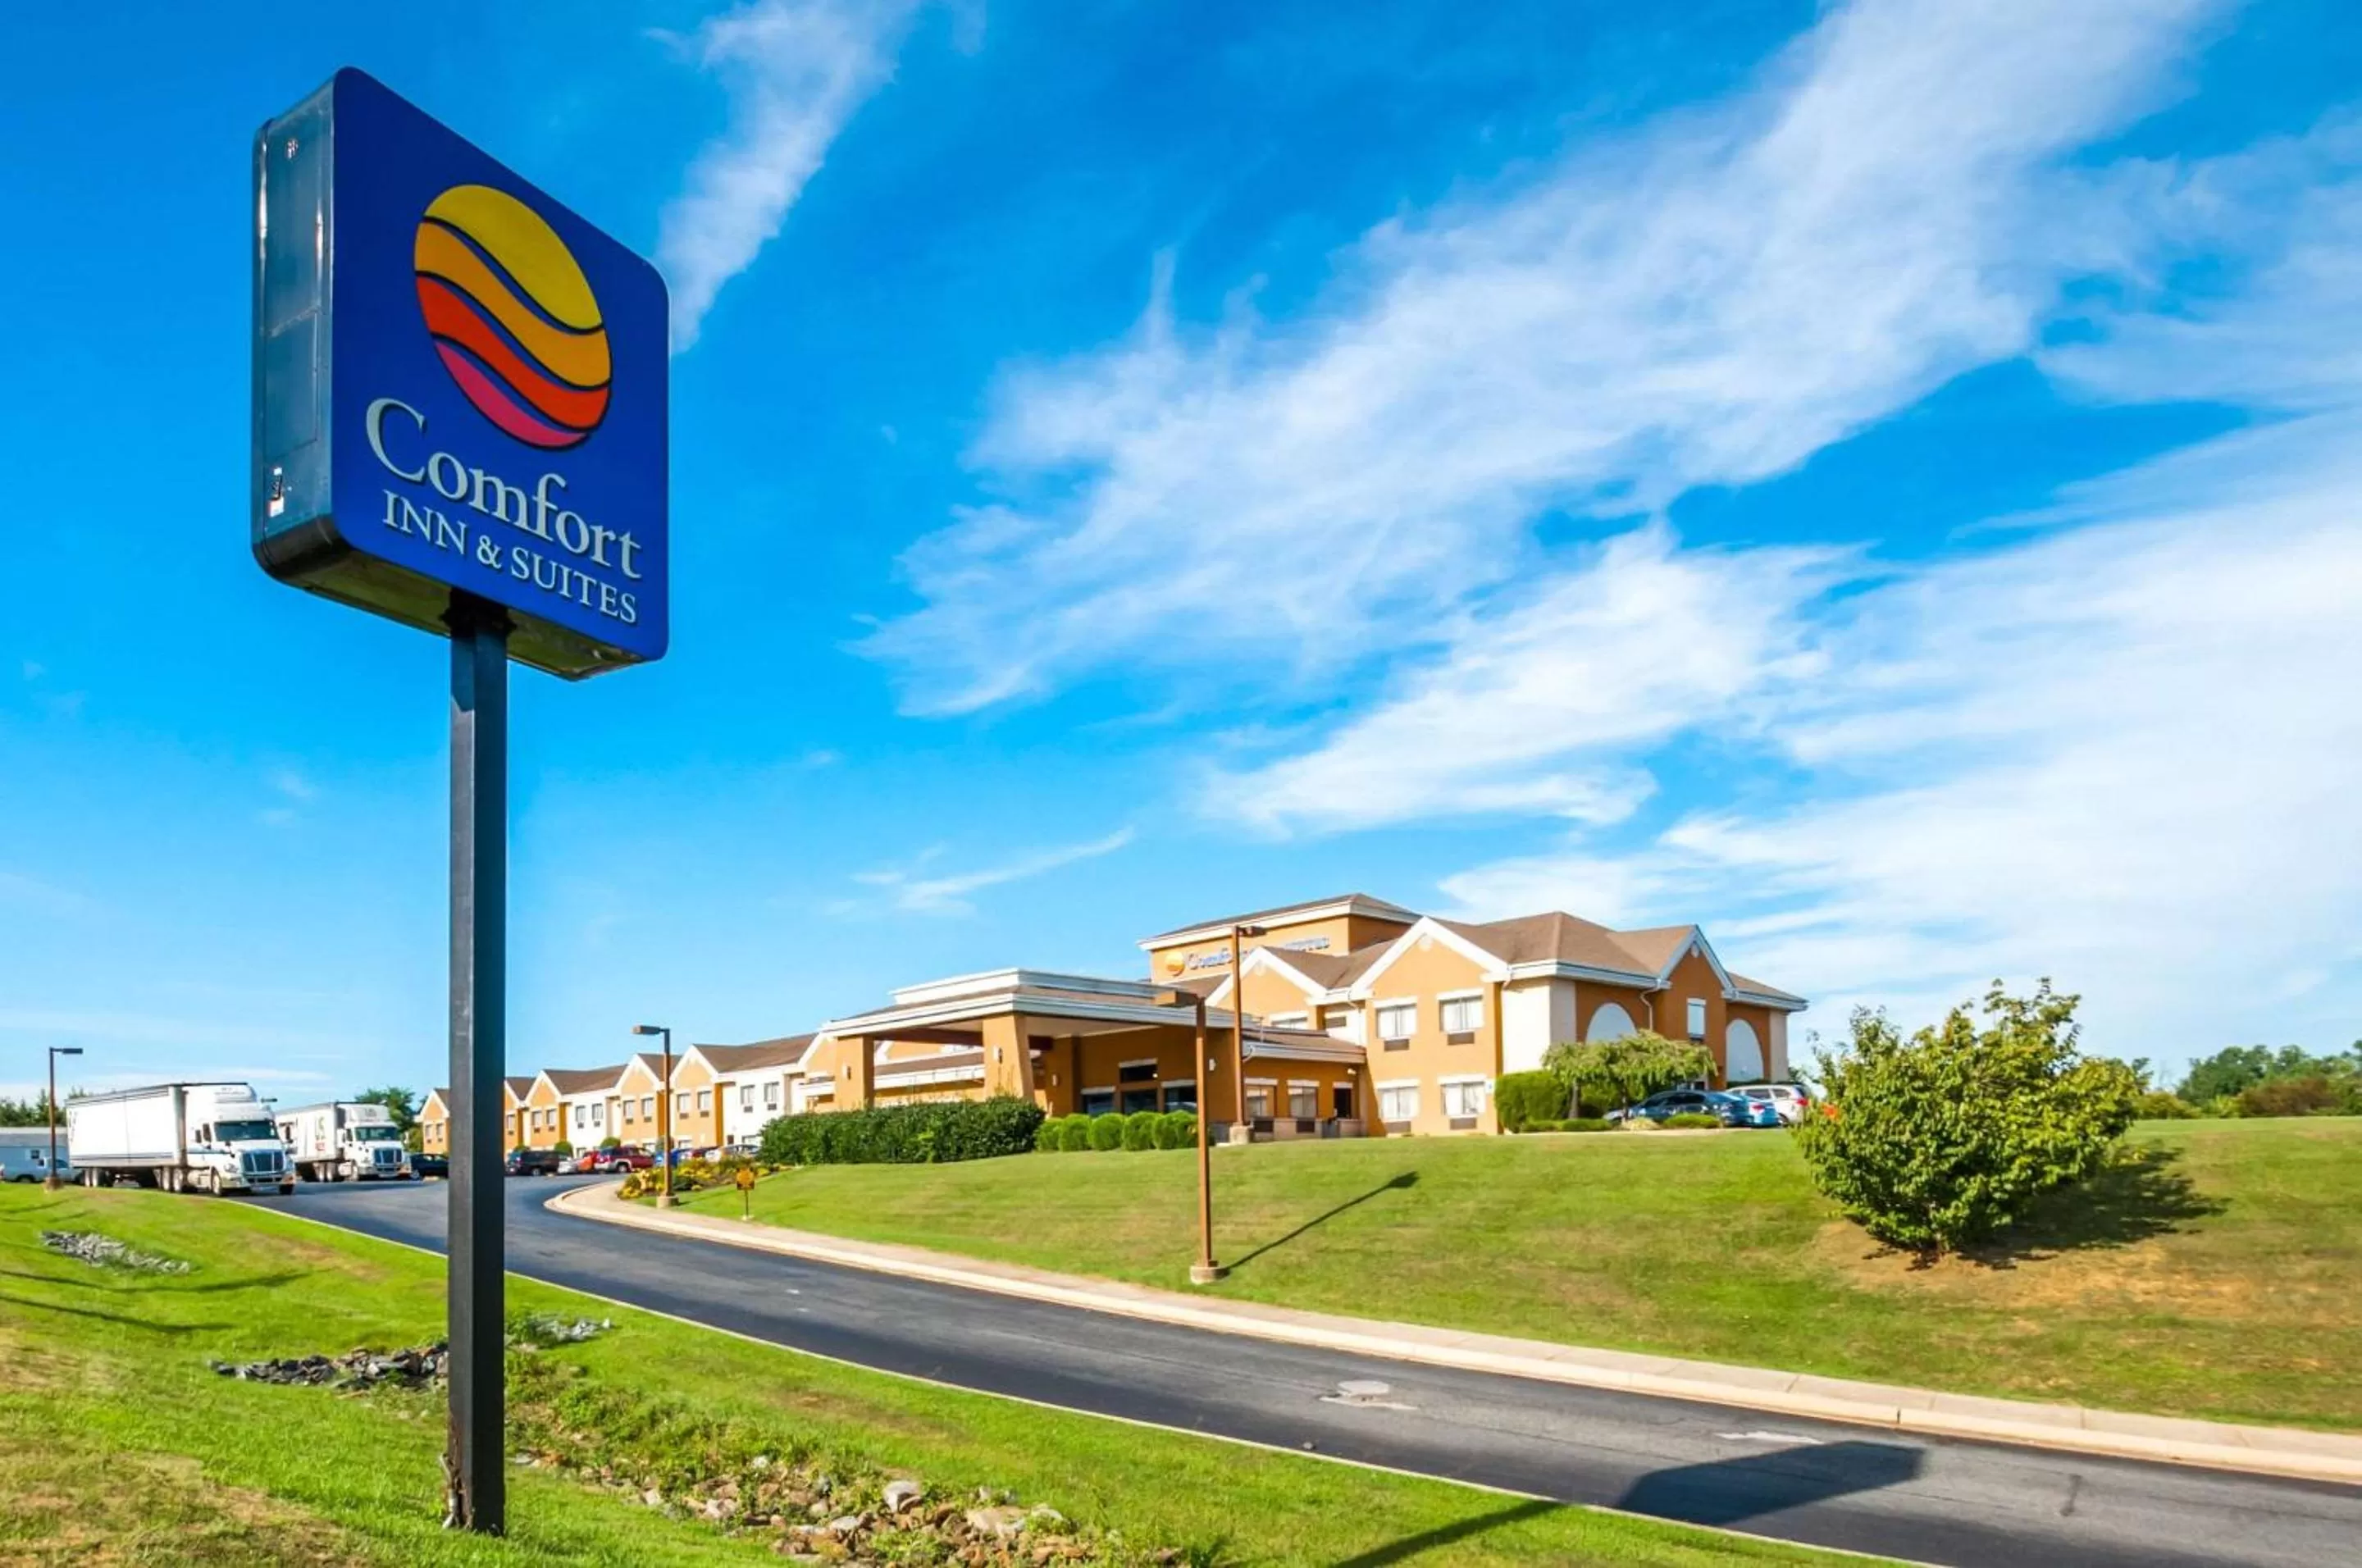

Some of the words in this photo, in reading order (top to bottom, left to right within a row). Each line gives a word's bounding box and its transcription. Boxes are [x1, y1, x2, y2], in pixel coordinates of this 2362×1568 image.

[366, 397, 642, 579] Comfort
[382, 489, 468, 555] INN
[477, 534, 502, 569] &
[511, 546, 636, 624] SUITES
